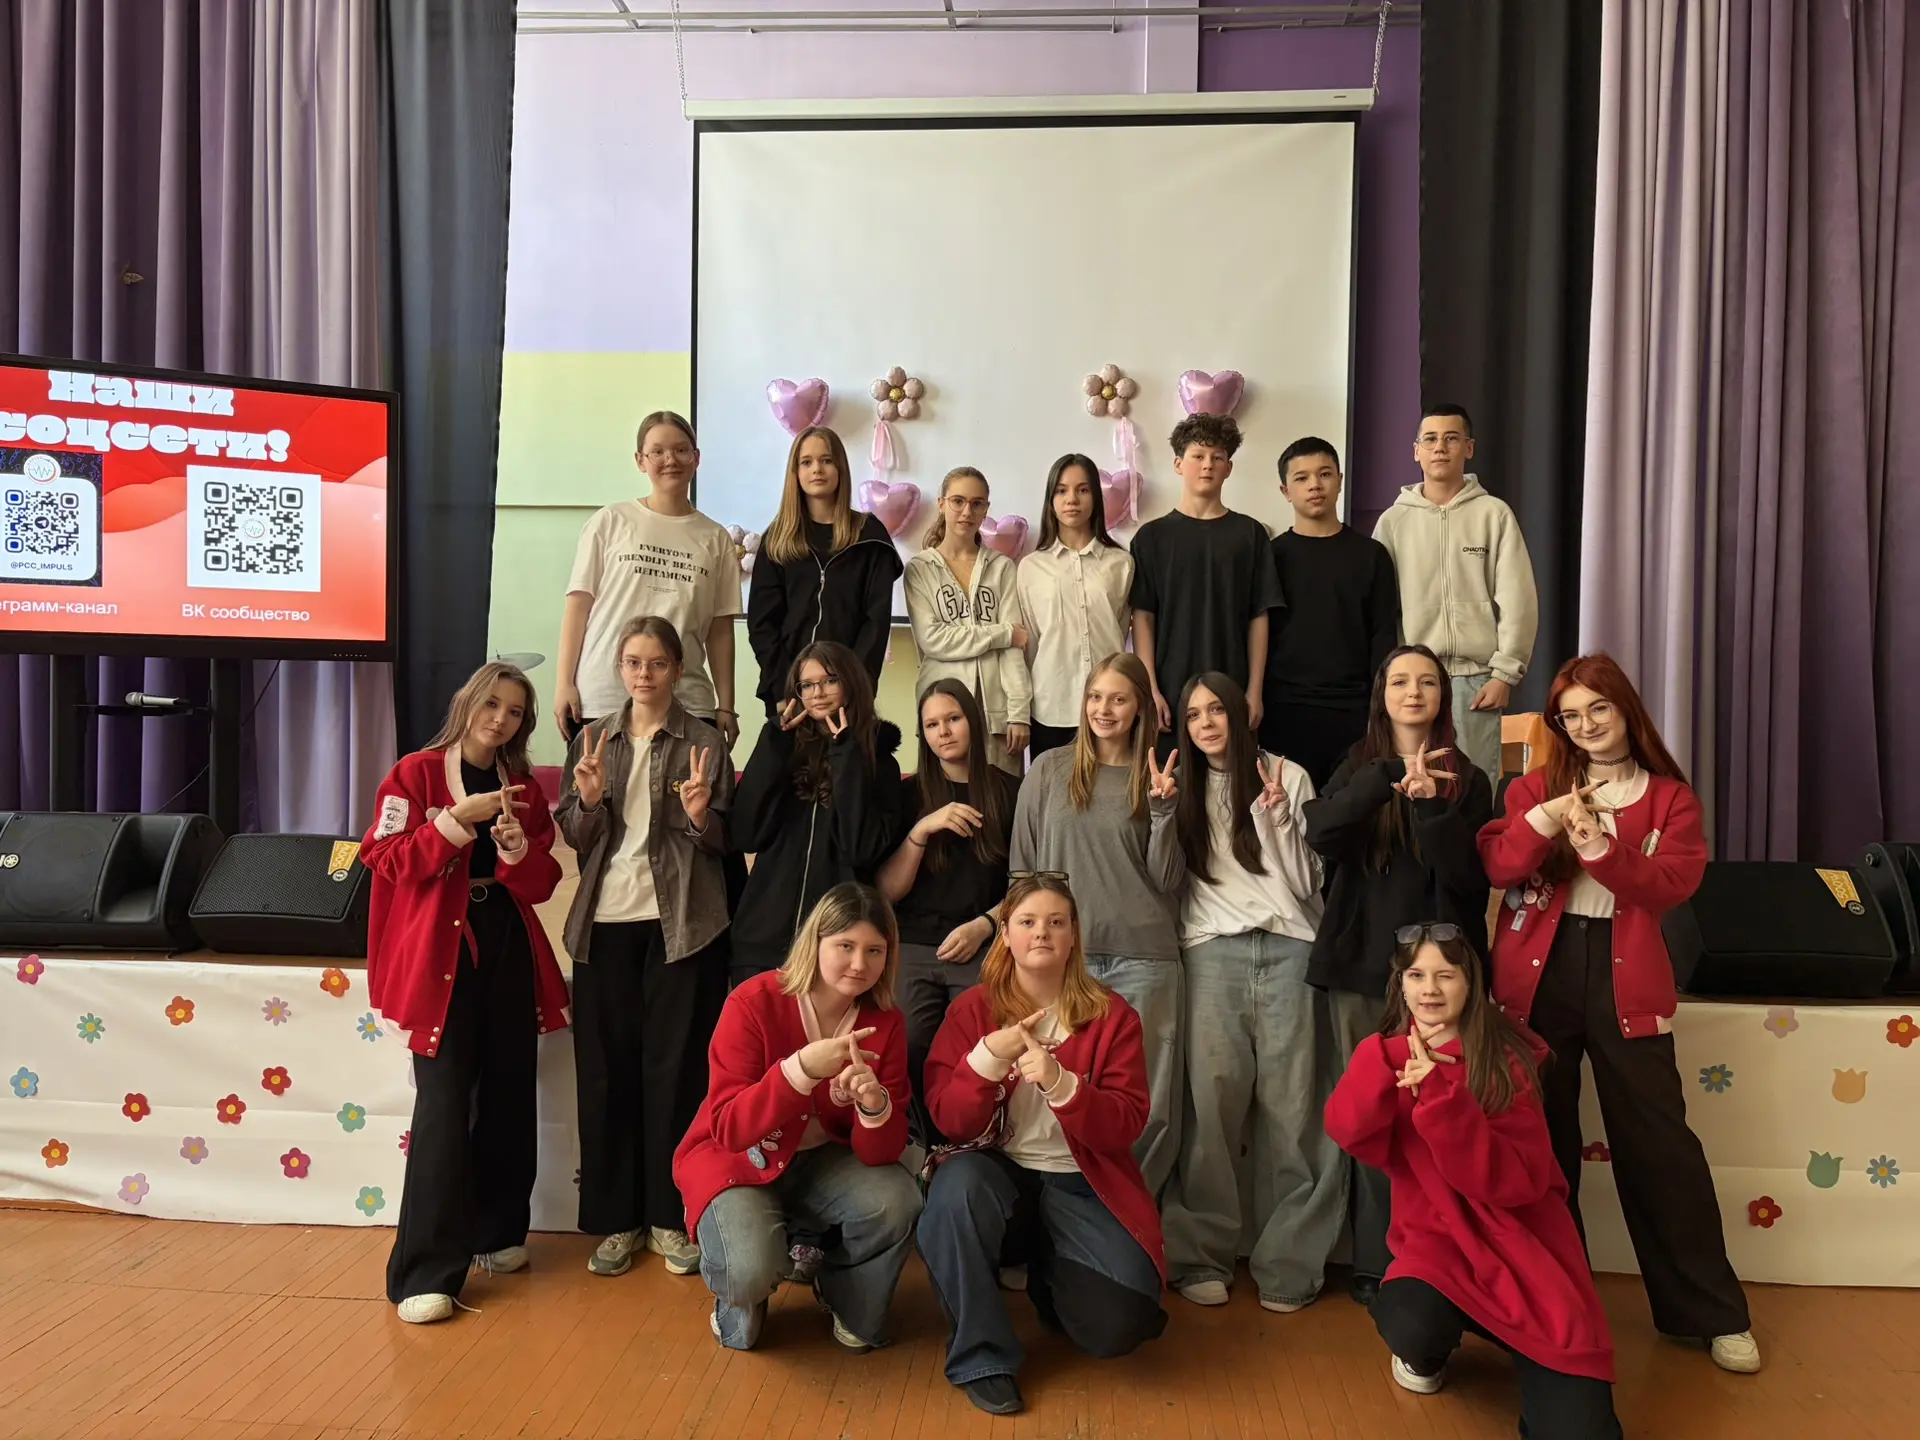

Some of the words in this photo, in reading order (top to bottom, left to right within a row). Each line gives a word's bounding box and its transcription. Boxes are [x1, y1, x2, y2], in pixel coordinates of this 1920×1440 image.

[0, 411, 291, 462] соцсети!
[640, 544, 693, 560] EVERYONE
[10, 561, 73, 571] @PCC_IMPULS
[0, 599, 118, 615] грамм-канал
[182, 603, 206, 618] ВК
[209, 606, 310, 622] сообщество
